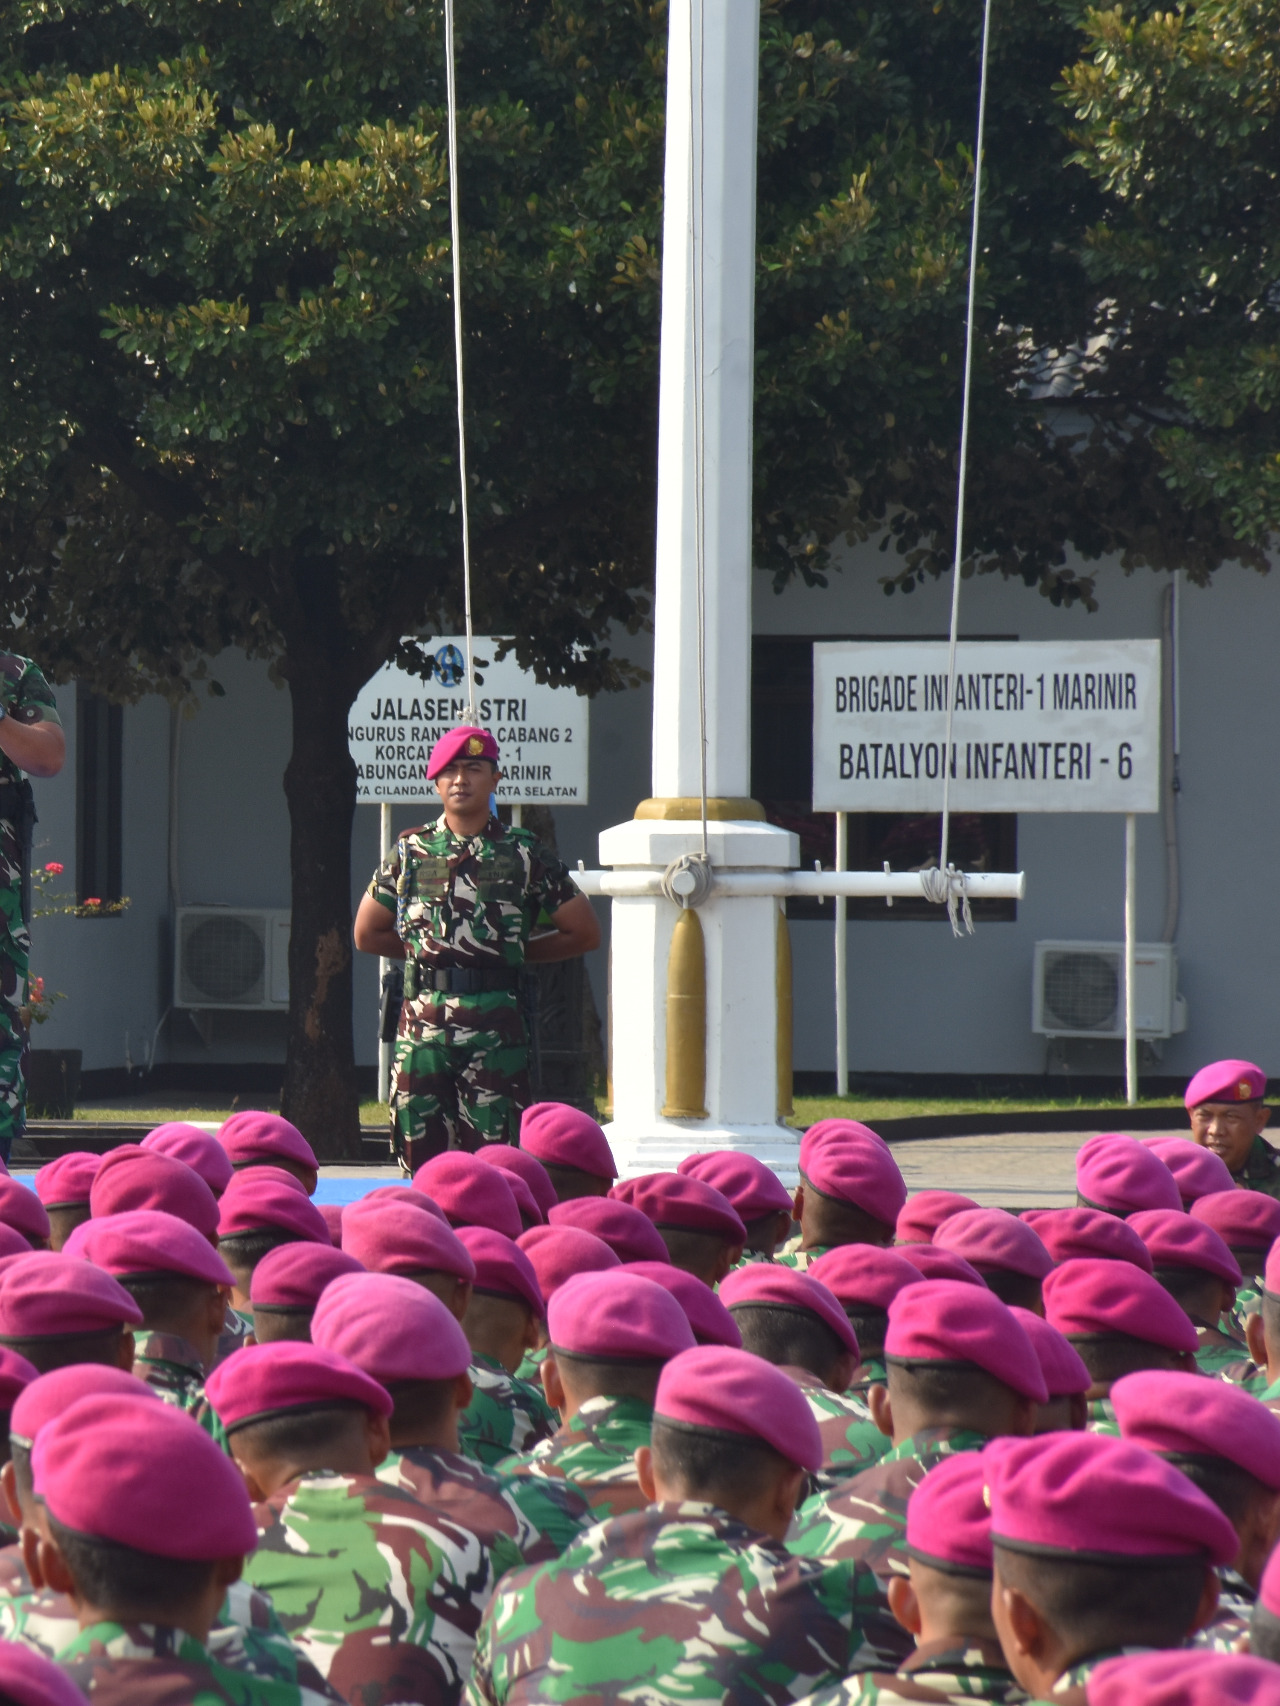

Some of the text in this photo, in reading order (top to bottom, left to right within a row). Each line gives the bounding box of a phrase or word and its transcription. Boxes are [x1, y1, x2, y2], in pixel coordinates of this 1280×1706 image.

[835, 674, 918, 713] BRIGADE
[1052, 672, 1137, 711] MARINIR
[371, 698, 527, 722] JALASENSTRI
[347, 726, 405, 742] NGURUS
[497, 727, 560, 743] CABANG
[564, 727, 573, 743] 2
[515, 746, 522, 762] 1
[839, 742, 957, 780] BATALYON
[965, 742, 1092, 780] INFANTERI
[1117, 741, 1133, 779] 6
[357, 764, 552, 781] ABUNGAN ARINIR
[374, 785, 434, 796] CILANDAK
[524, 786, 578, 797] SELATAN
